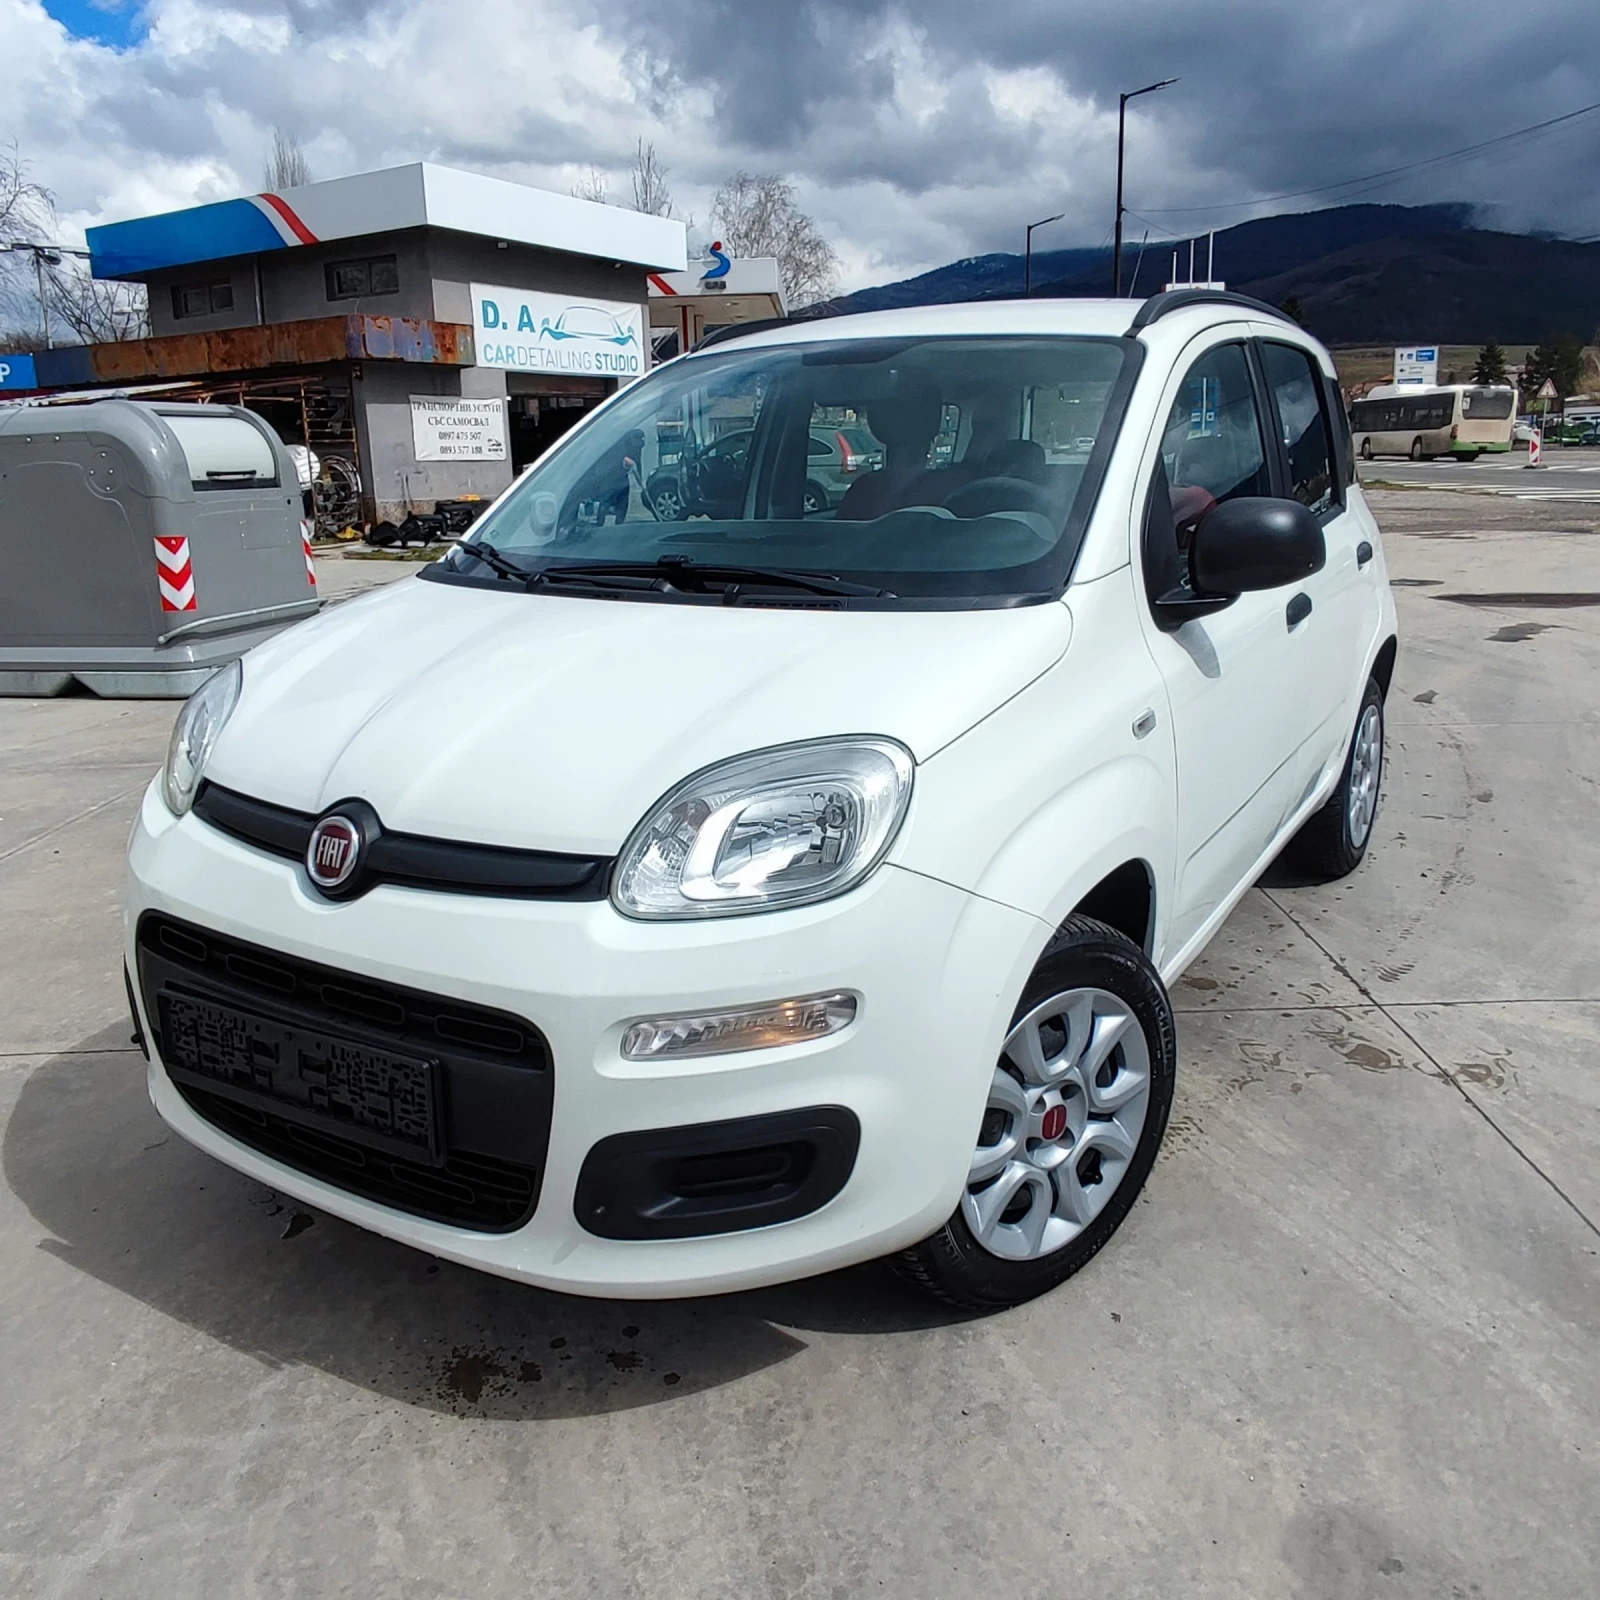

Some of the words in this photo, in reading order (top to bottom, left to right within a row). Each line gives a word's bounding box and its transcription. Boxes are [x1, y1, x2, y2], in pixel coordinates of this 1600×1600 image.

[481, 299, 508, 331] D.
[517, 304, 536, 333] A
[594, 354, 639, 373] STUDIO
[428, 416, 445, 426] СЪС
[446, 416, 490, 427] САМОСВАЛ
[469, 431, 482, 441] 507
[316, 835, 349, 869] FIAT
